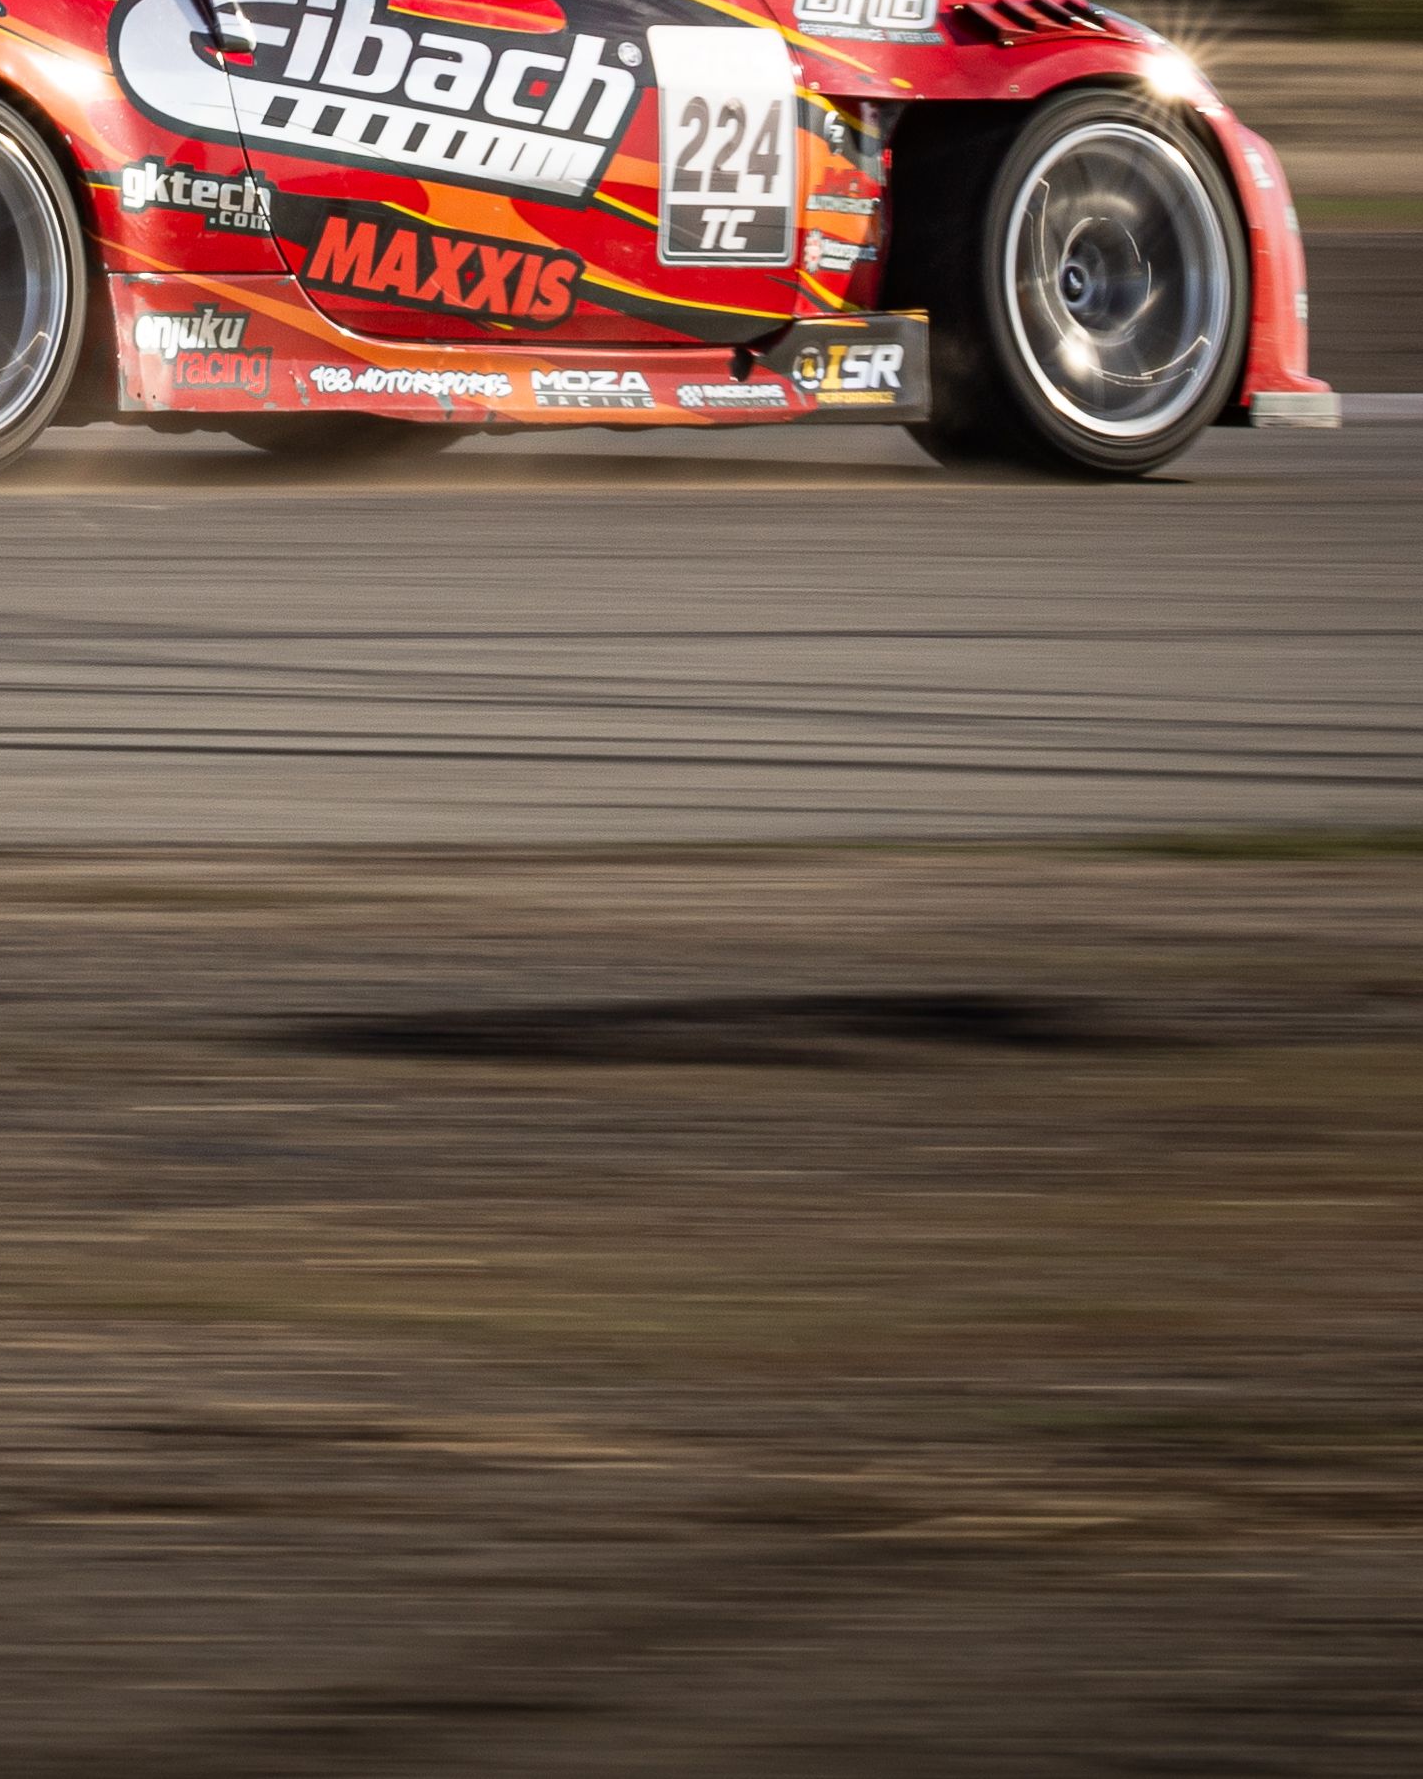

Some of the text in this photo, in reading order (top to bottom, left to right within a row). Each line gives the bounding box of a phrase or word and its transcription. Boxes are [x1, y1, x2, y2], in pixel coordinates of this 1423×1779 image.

[672, 96, 783, 194] 224
[122, 162, 272, 216] gktech
[699, 208, 757, 250] TC
[307, 216, 578, 322] MAXXIS
[177, 351, 268, 395] racing
[530, 370, 651, 392] MOZA
[820, 344, 905, 390] ISR
[535, 395, 656, 409] RACING
